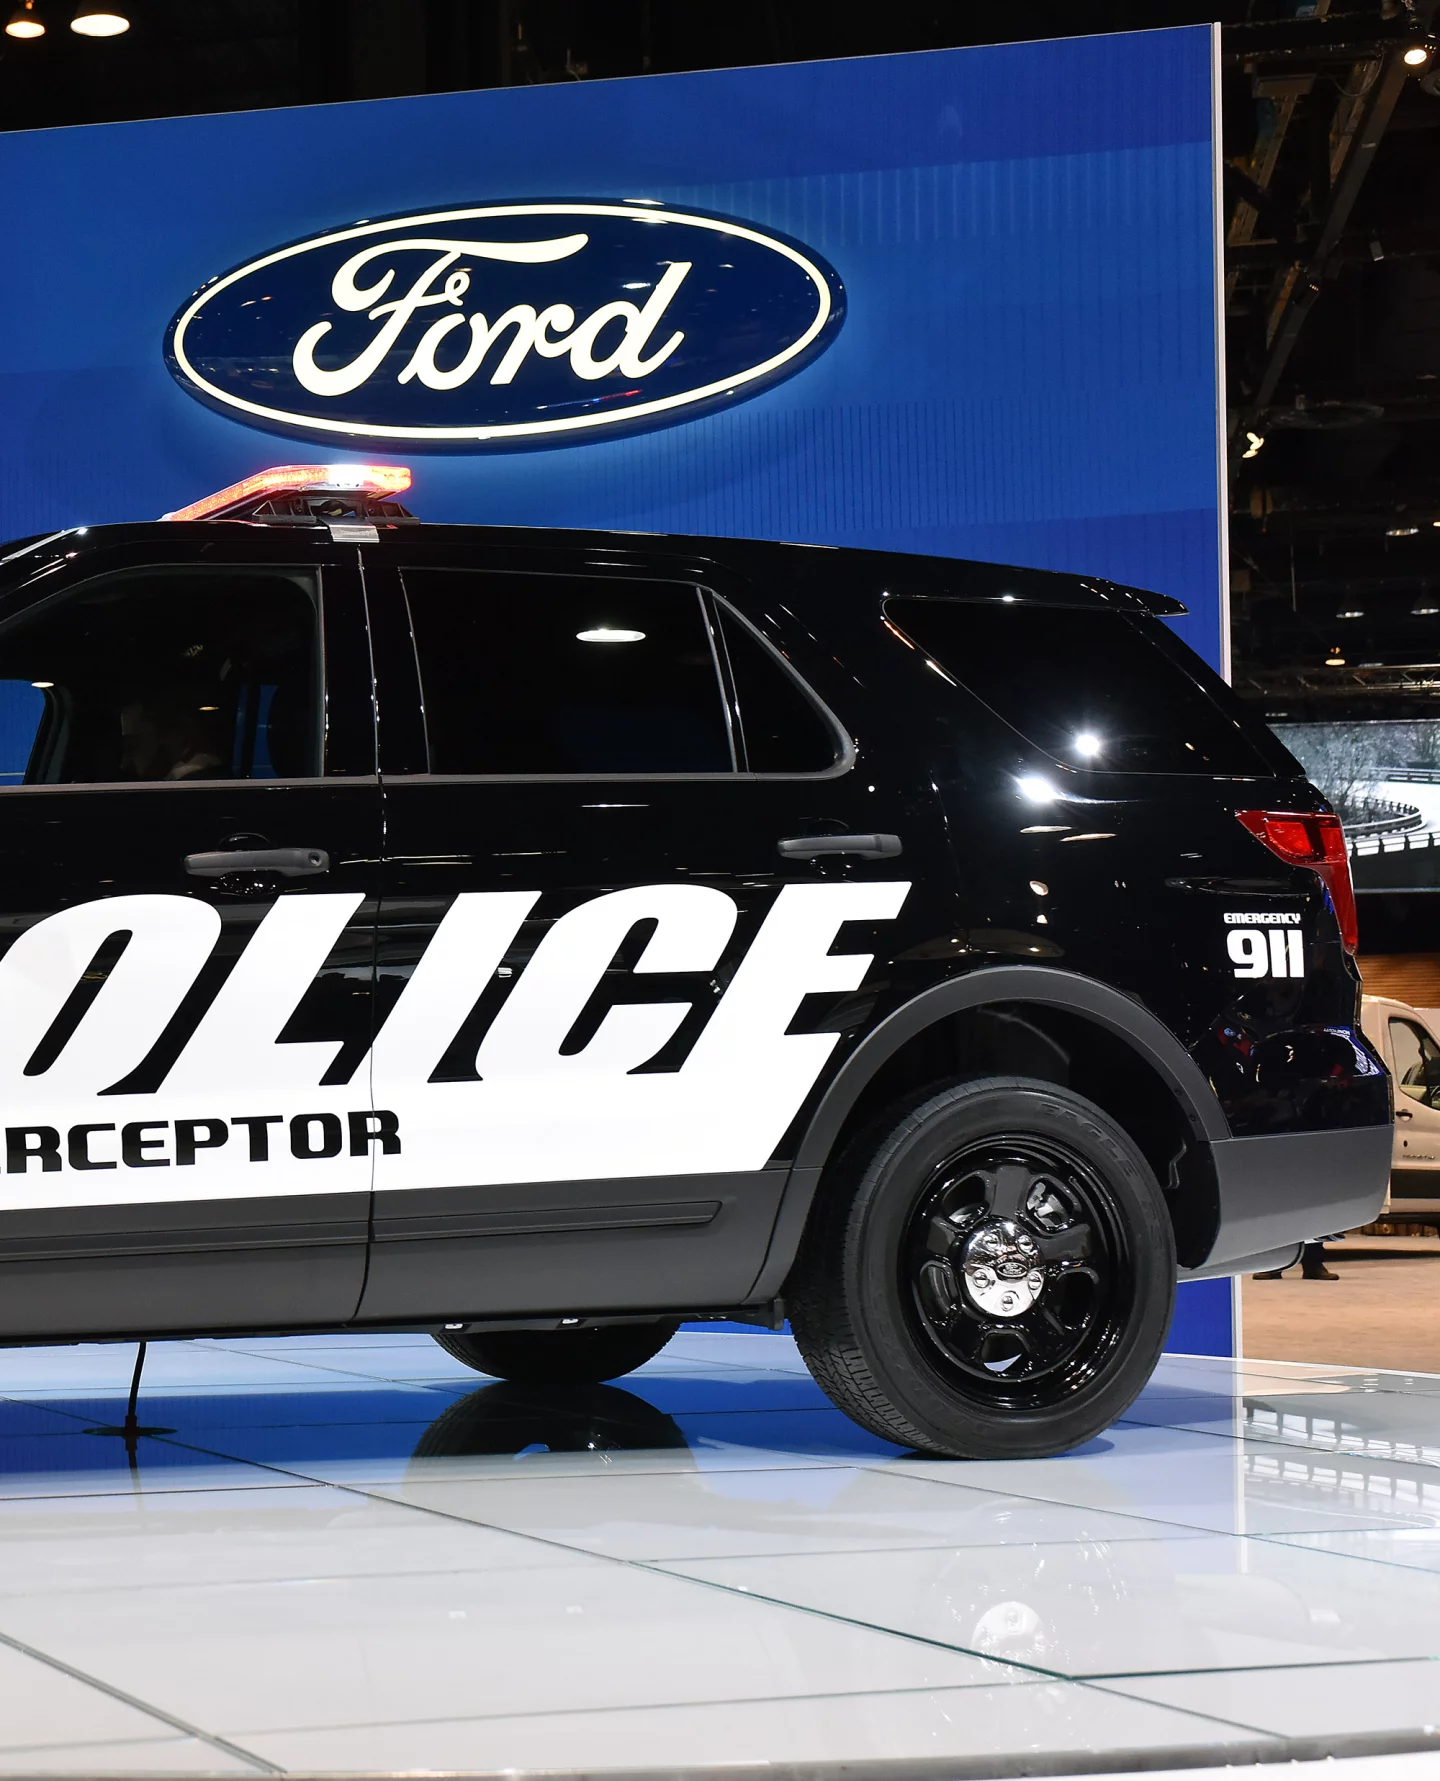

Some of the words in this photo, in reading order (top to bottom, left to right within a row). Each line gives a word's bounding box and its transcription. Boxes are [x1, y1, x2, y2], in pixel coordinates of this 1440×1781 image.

[292, 233, 693, 397] Ford
[1223, 912, 1302, 925] EMERGENCY
[1226, 929, 1305, 979] 911
